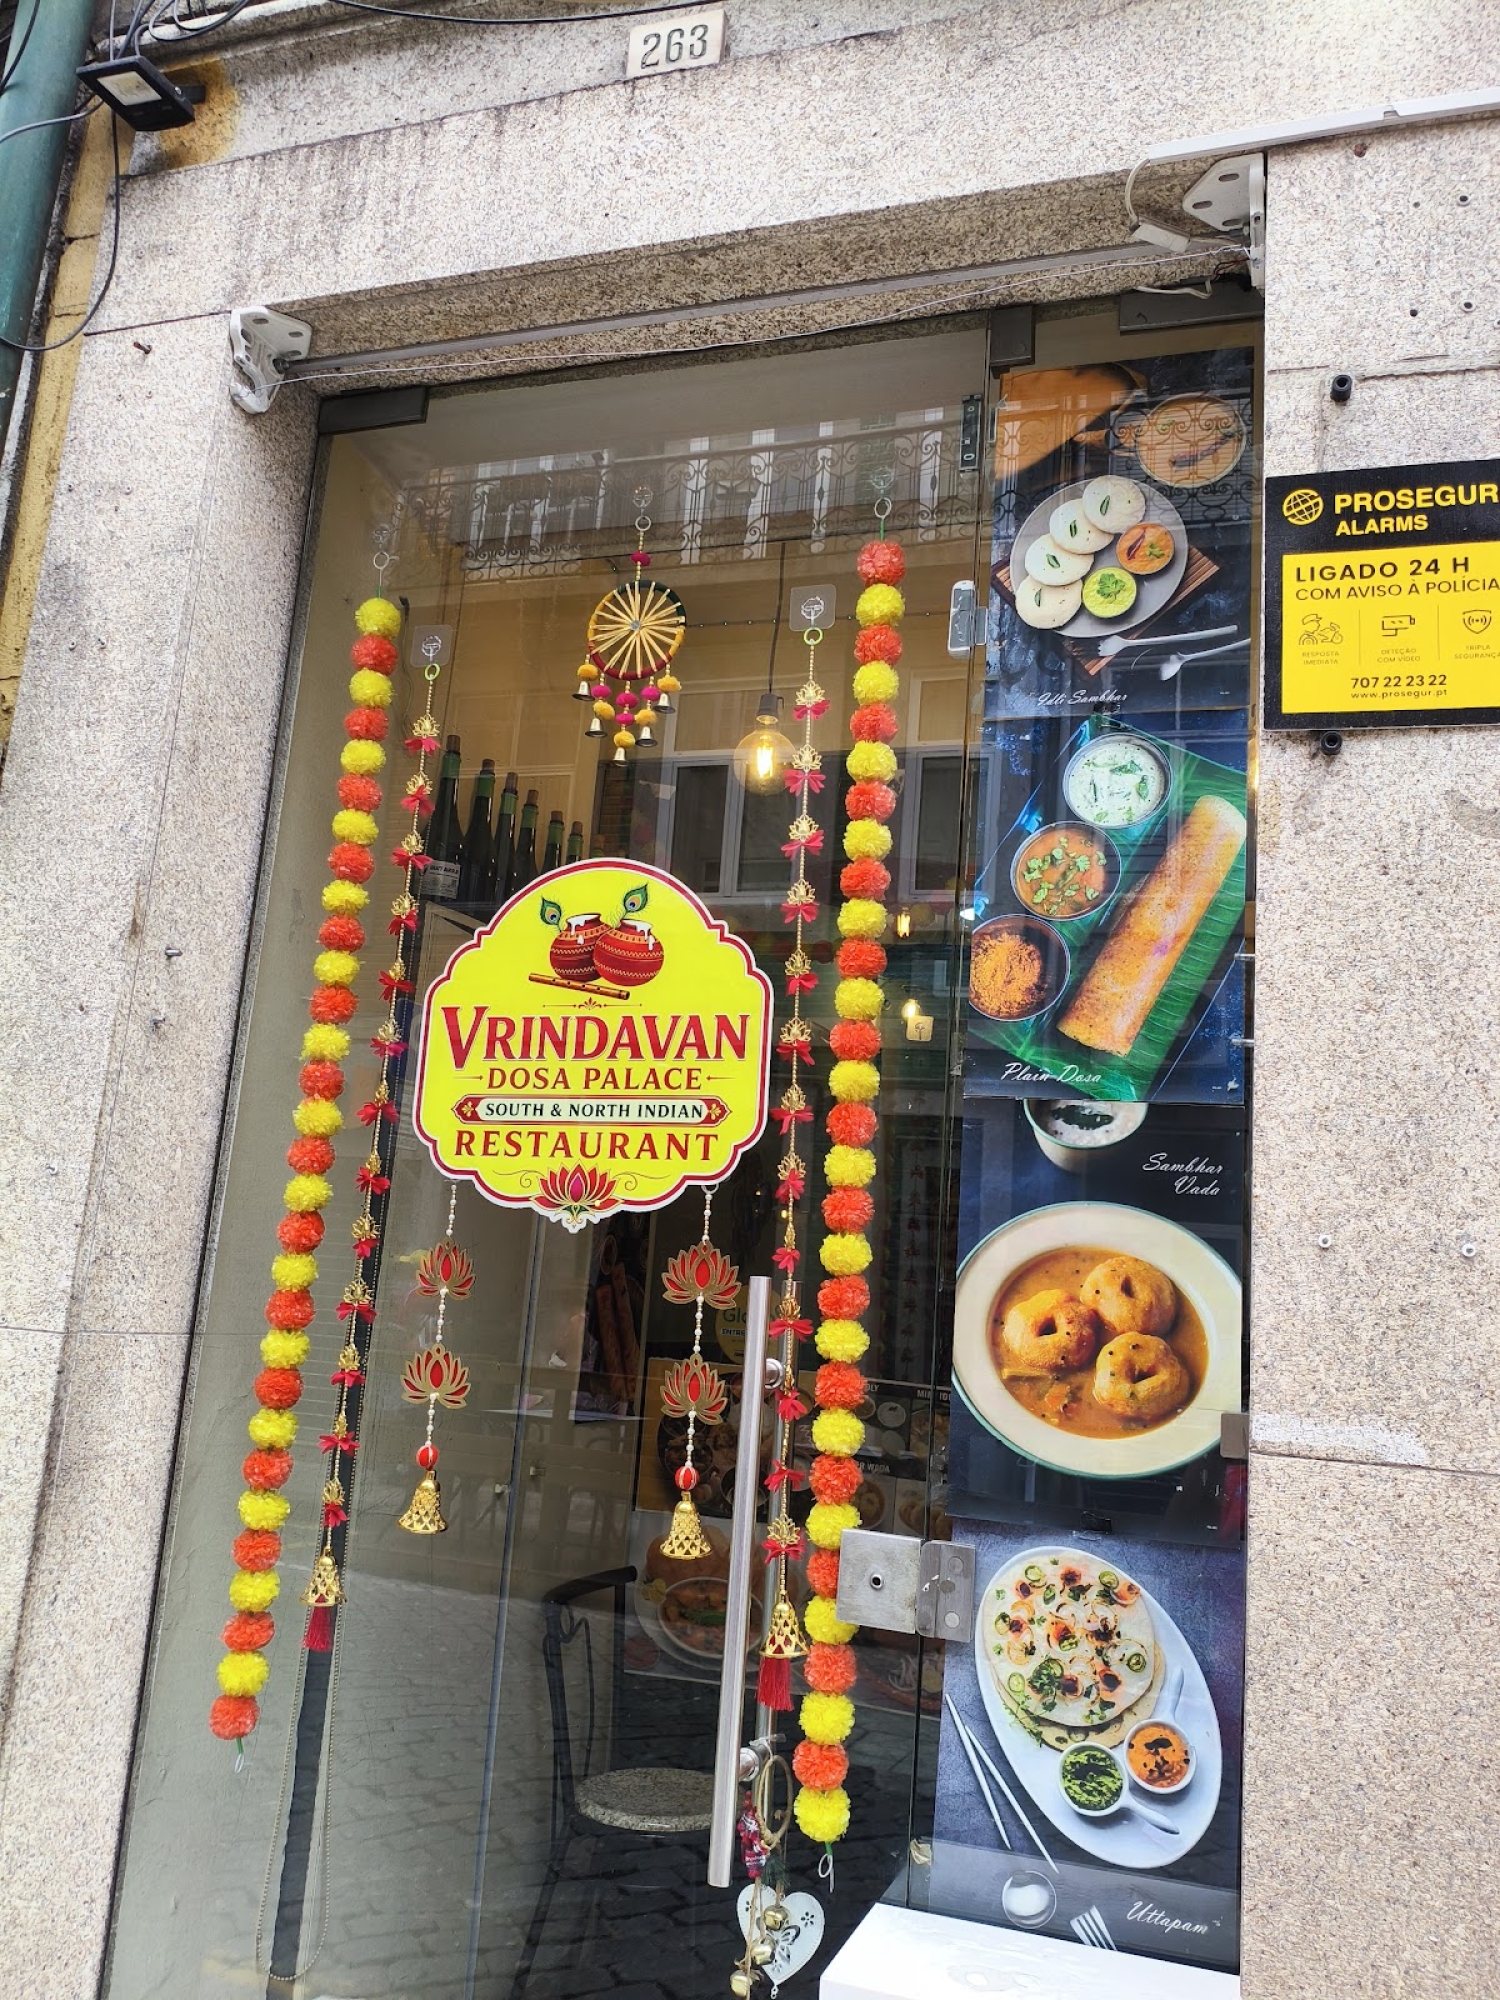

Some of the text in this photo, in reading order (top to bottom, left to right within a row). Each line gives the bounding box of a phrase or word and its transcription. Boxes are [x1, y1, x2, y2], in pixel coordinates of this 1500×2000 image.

[641, 24, 709, 69] 263
[1334, 483, 1499, 515] PROSEGUR
[1335, 514, 1429, 536] ALARMS
[1295, 556, 1470, 583] LIGADO 24 H
[1295, 587, 1341, 601] COM
[1346, 583, 1402, 600] AVISO
[1426, 575, 1500, 594] POLÍCIA
[1350, 673, 1447, 689] 707 22 23 22
[1068, 689, 1128, 705] Sambhar
[1350, 688, 1448, 700] www.prosegur.pt
[440, 1005, 751, 1070] VRINDAVAN
[487, 1067, 702, 1091] DOSA PALACE
[1000, 1062, 1102, 1083] Plain Dosa
[485, 1102, 703, 1120] SOUTH & NORTH INDIAN
[454, 1129, 719, 1162] RESTAURANT
[1142, 1152, 1223, 1175] Sambhar
[1174, 1175, 1221, 1196] Vada
[1126, 1901, 1209, 1934] Uttapam
